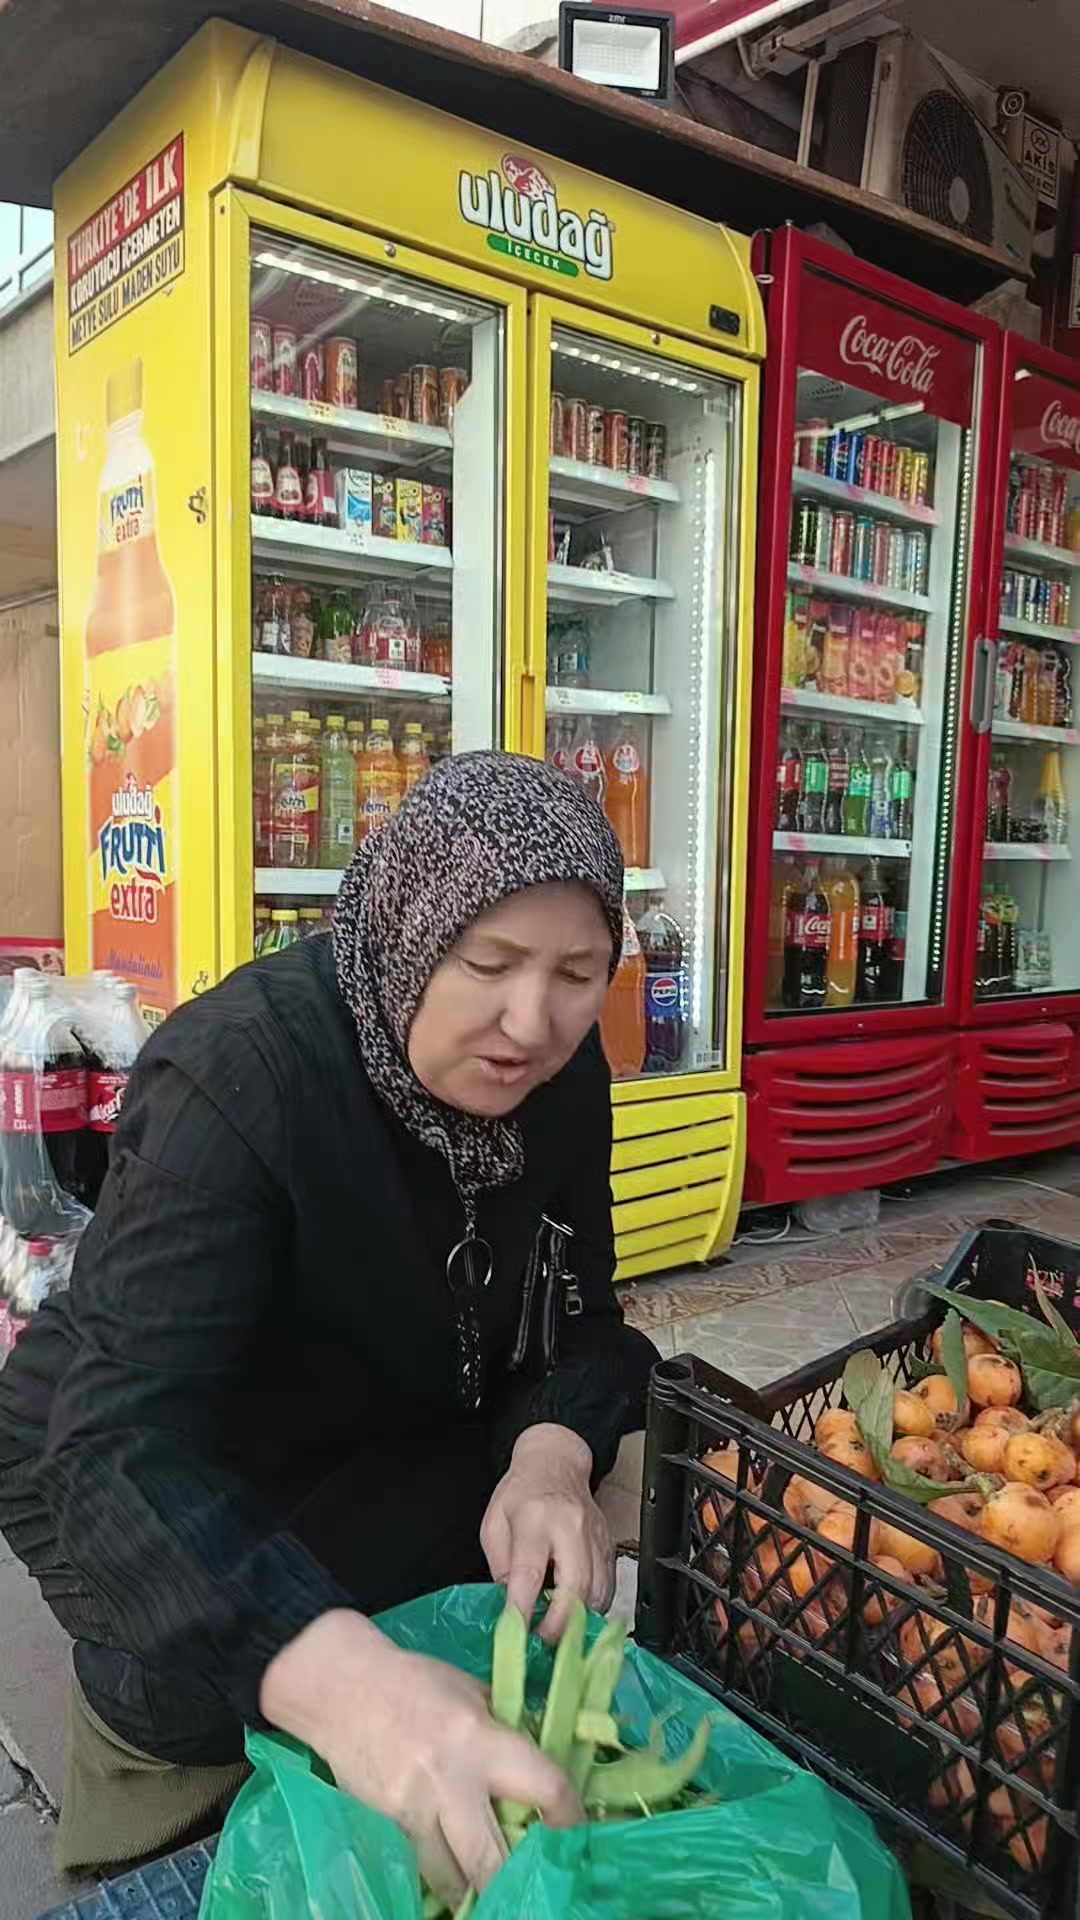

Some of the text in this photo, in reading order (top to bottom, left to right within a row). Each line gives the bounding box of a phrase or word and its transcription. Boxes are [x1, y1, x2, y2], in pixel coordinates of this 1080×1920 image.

[70, 244, 121, 312] KORUYUCU
[122, 257, 153, 308] MADEN
[154, 238, 181, 283] SUYU
[110, 882, 156, 921] extra
